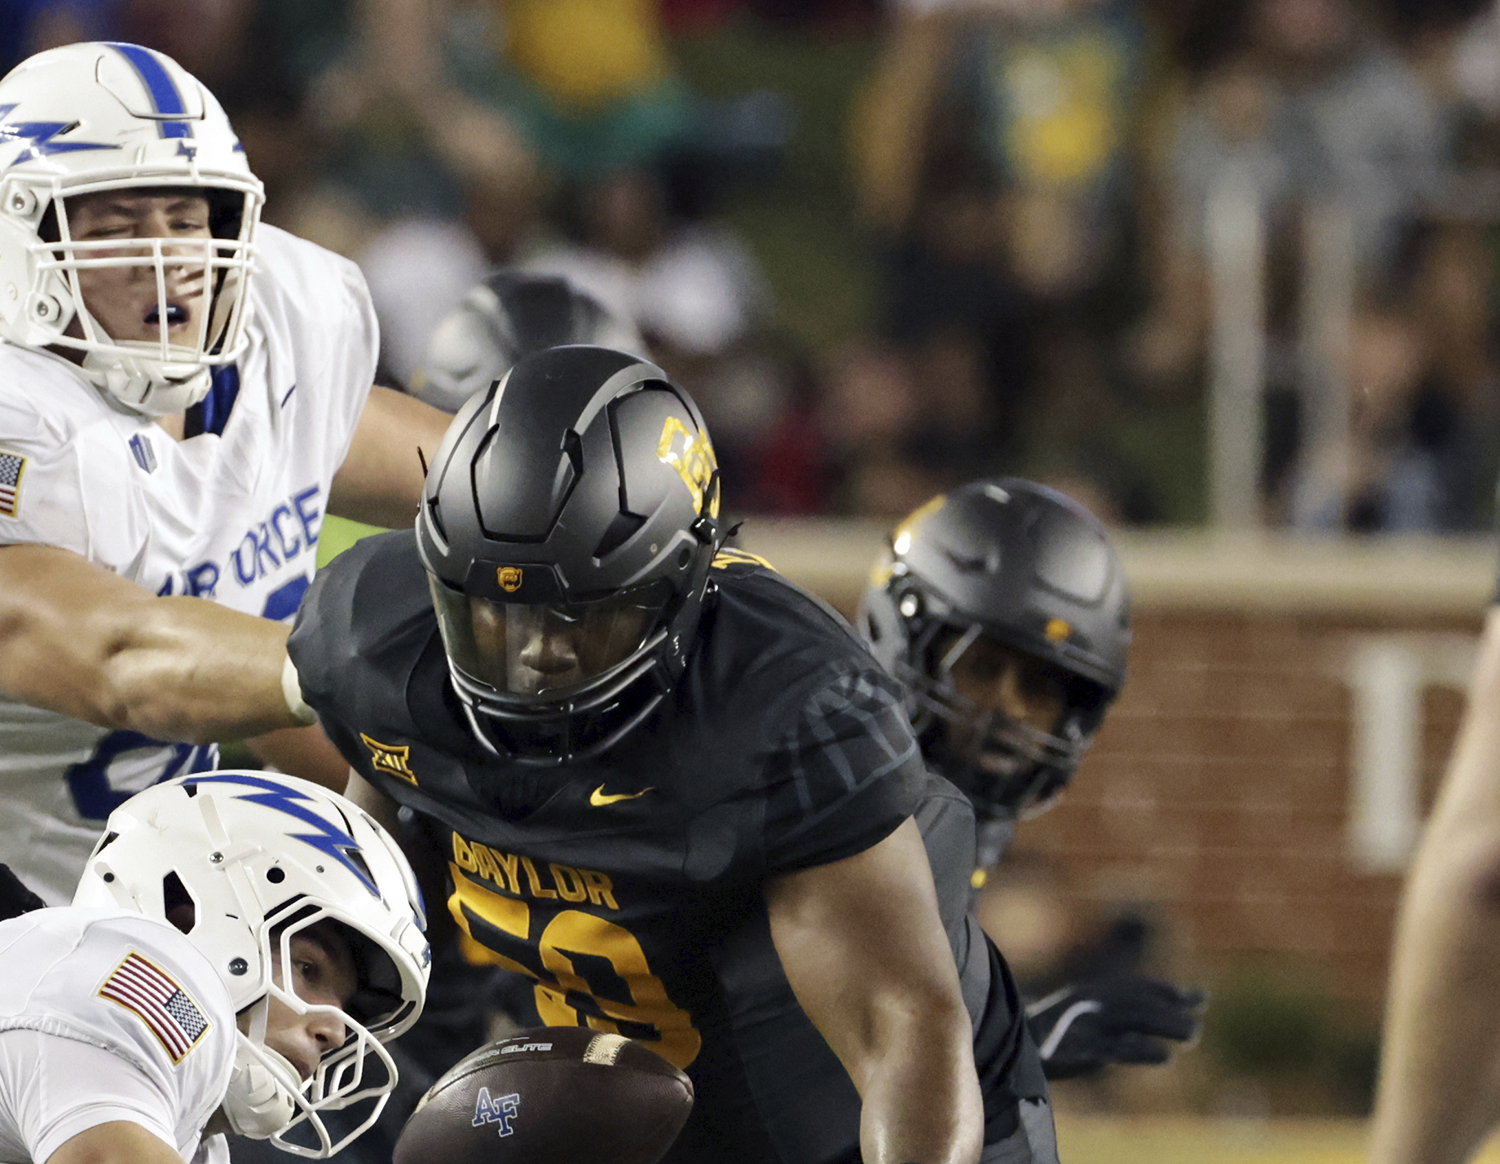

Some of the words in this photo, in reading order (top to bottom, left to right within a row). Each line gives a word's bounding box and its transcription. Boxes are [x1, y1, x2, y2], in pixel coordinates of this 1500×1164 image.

[232, 487, 320, 586] ORCE
[452, 830, 620, 910] BAYLOR
[472, 1087, 520, 1137] AF
